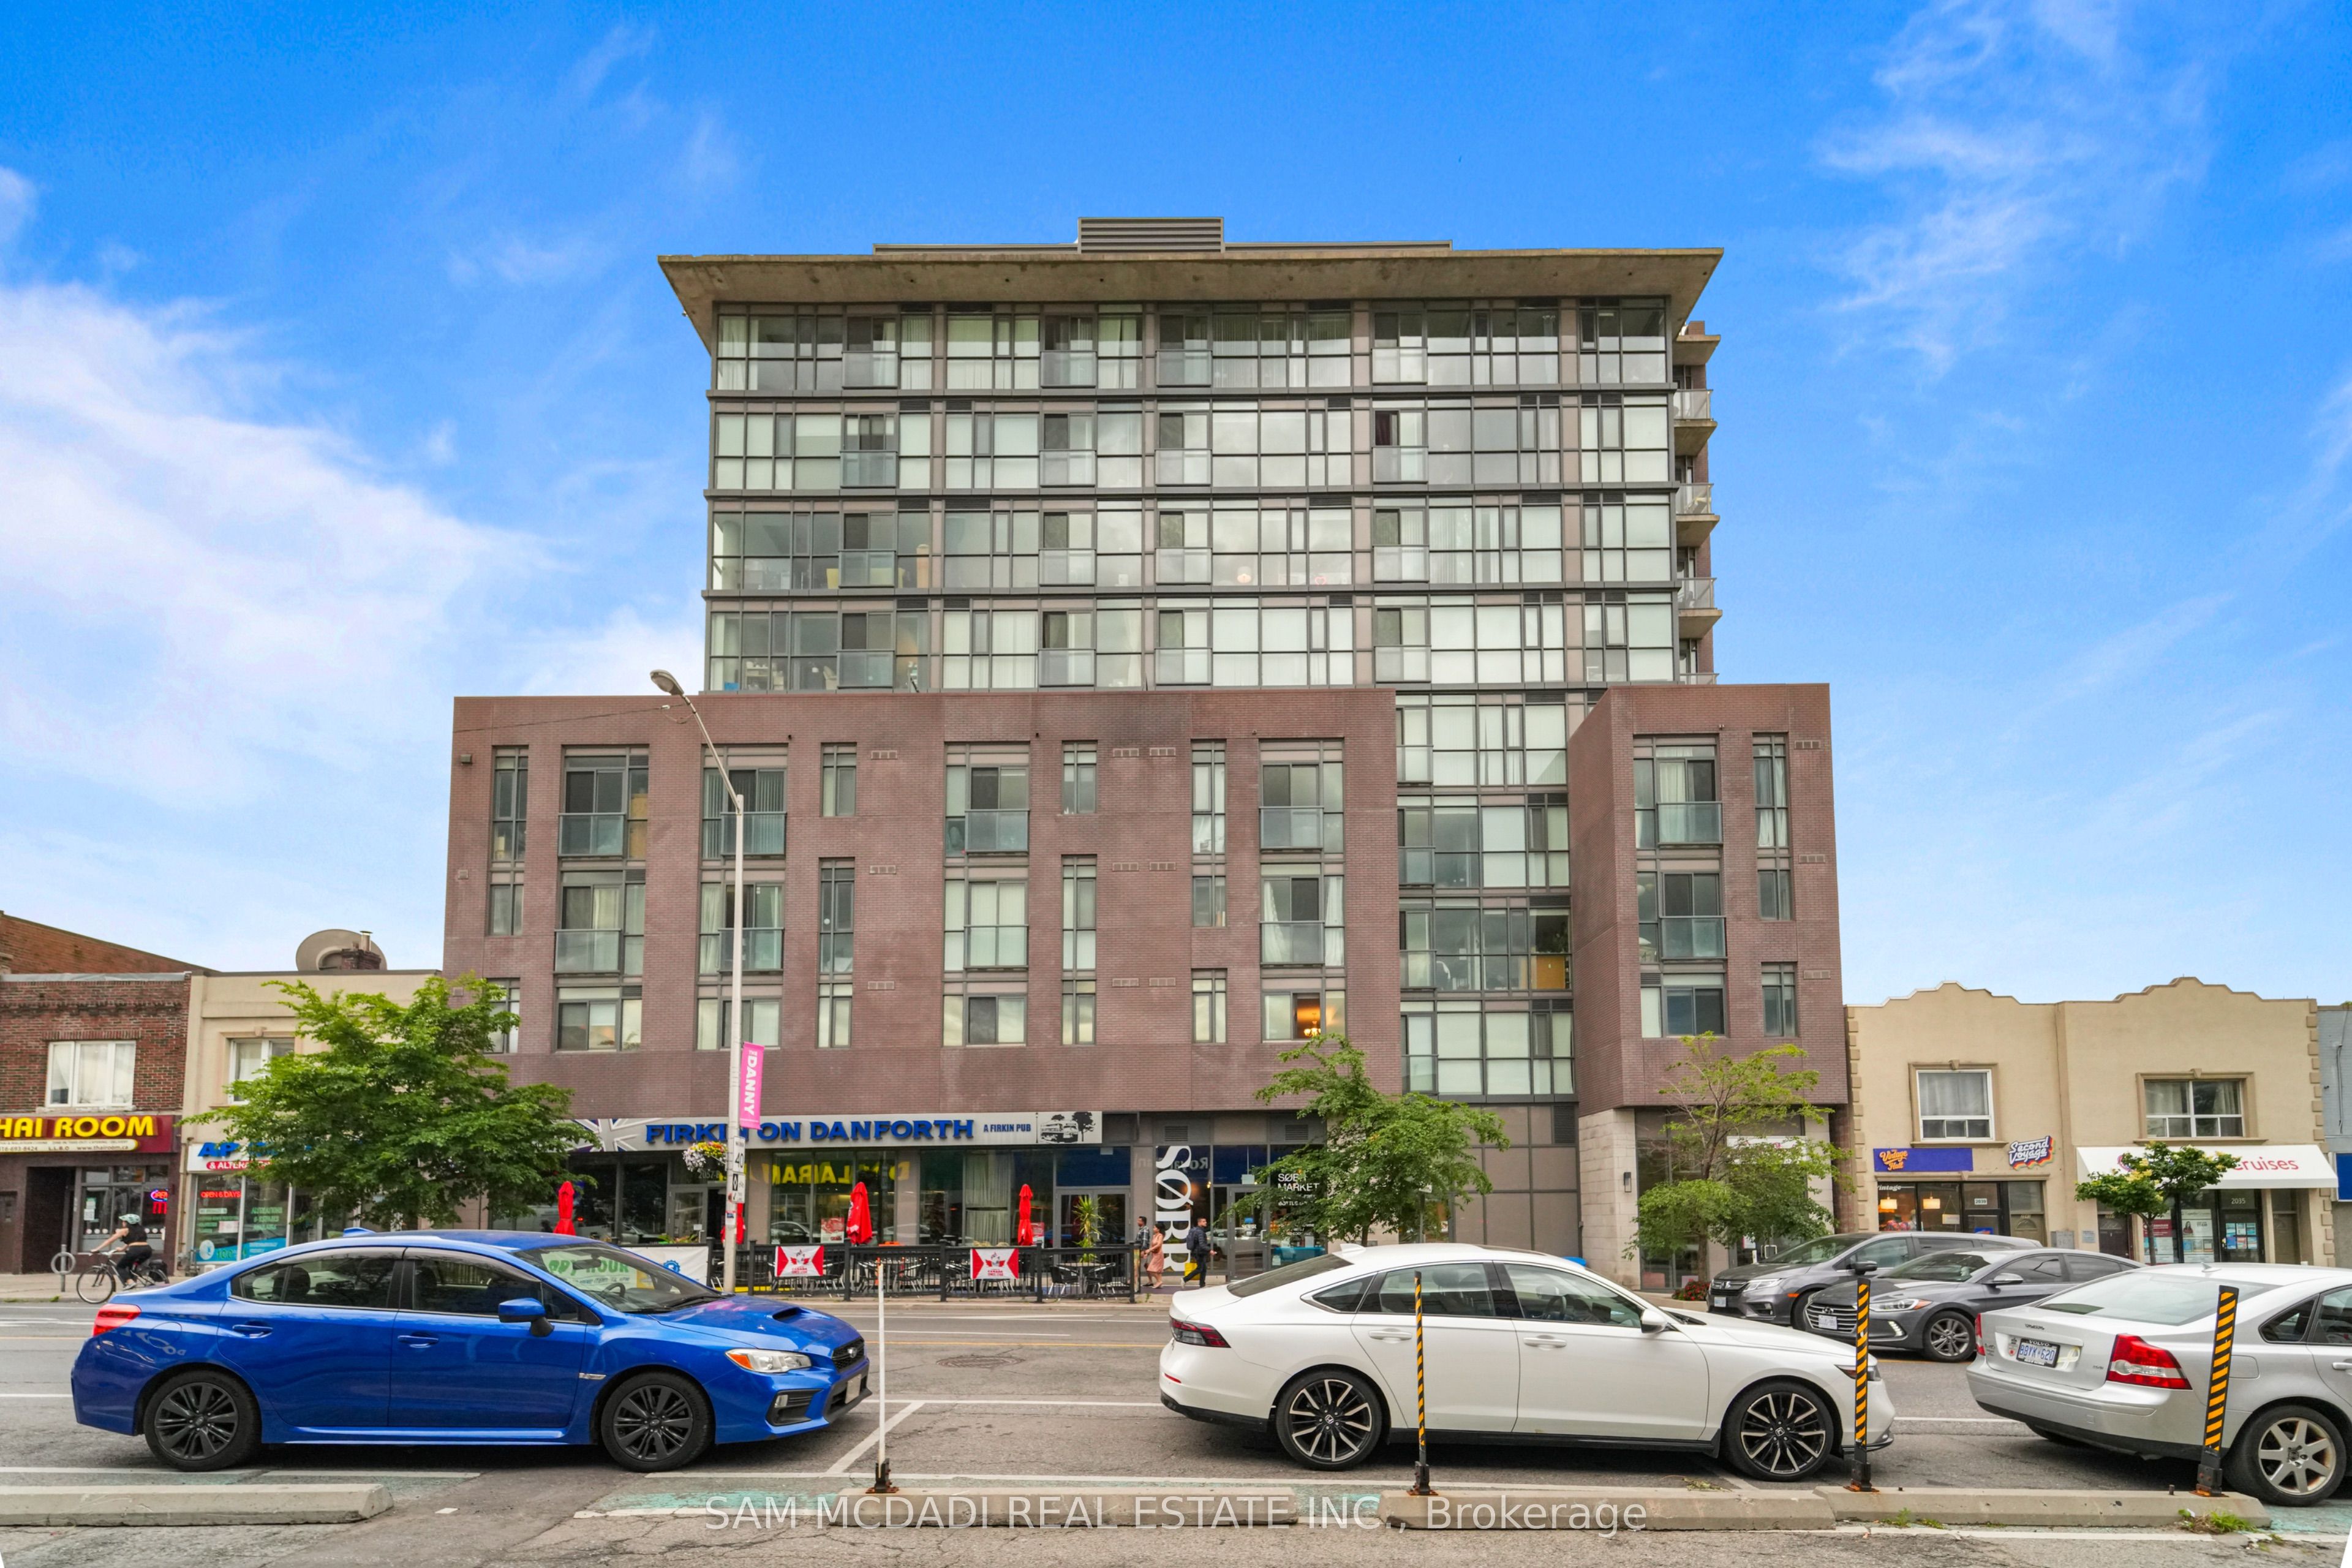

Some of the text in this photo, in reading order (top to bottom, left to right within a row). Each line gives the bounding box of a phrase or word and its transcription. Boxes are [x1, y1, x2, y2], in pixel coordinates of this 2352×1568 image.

[744, 1055, 758, 1116] DANNY
[54, 1116, 154, 1137] ROOM
[757, 1121, 802, 1141] ON
[810, 1120, 974, 1141] DANFORTH
[983, 1123, 1031, 1133] A FIRKIN PUB
[2008, 1136, 2049, 1154] Second
[735, 1152, 744, 1168] 40
[1879, 1150, 1908, 1163] Vintage
[2009, 1148, 2048, 1164] Voyage
[1278, 1182, 1320, 1191] MARKET
[2040, 1348, 2056, 1361] 620
